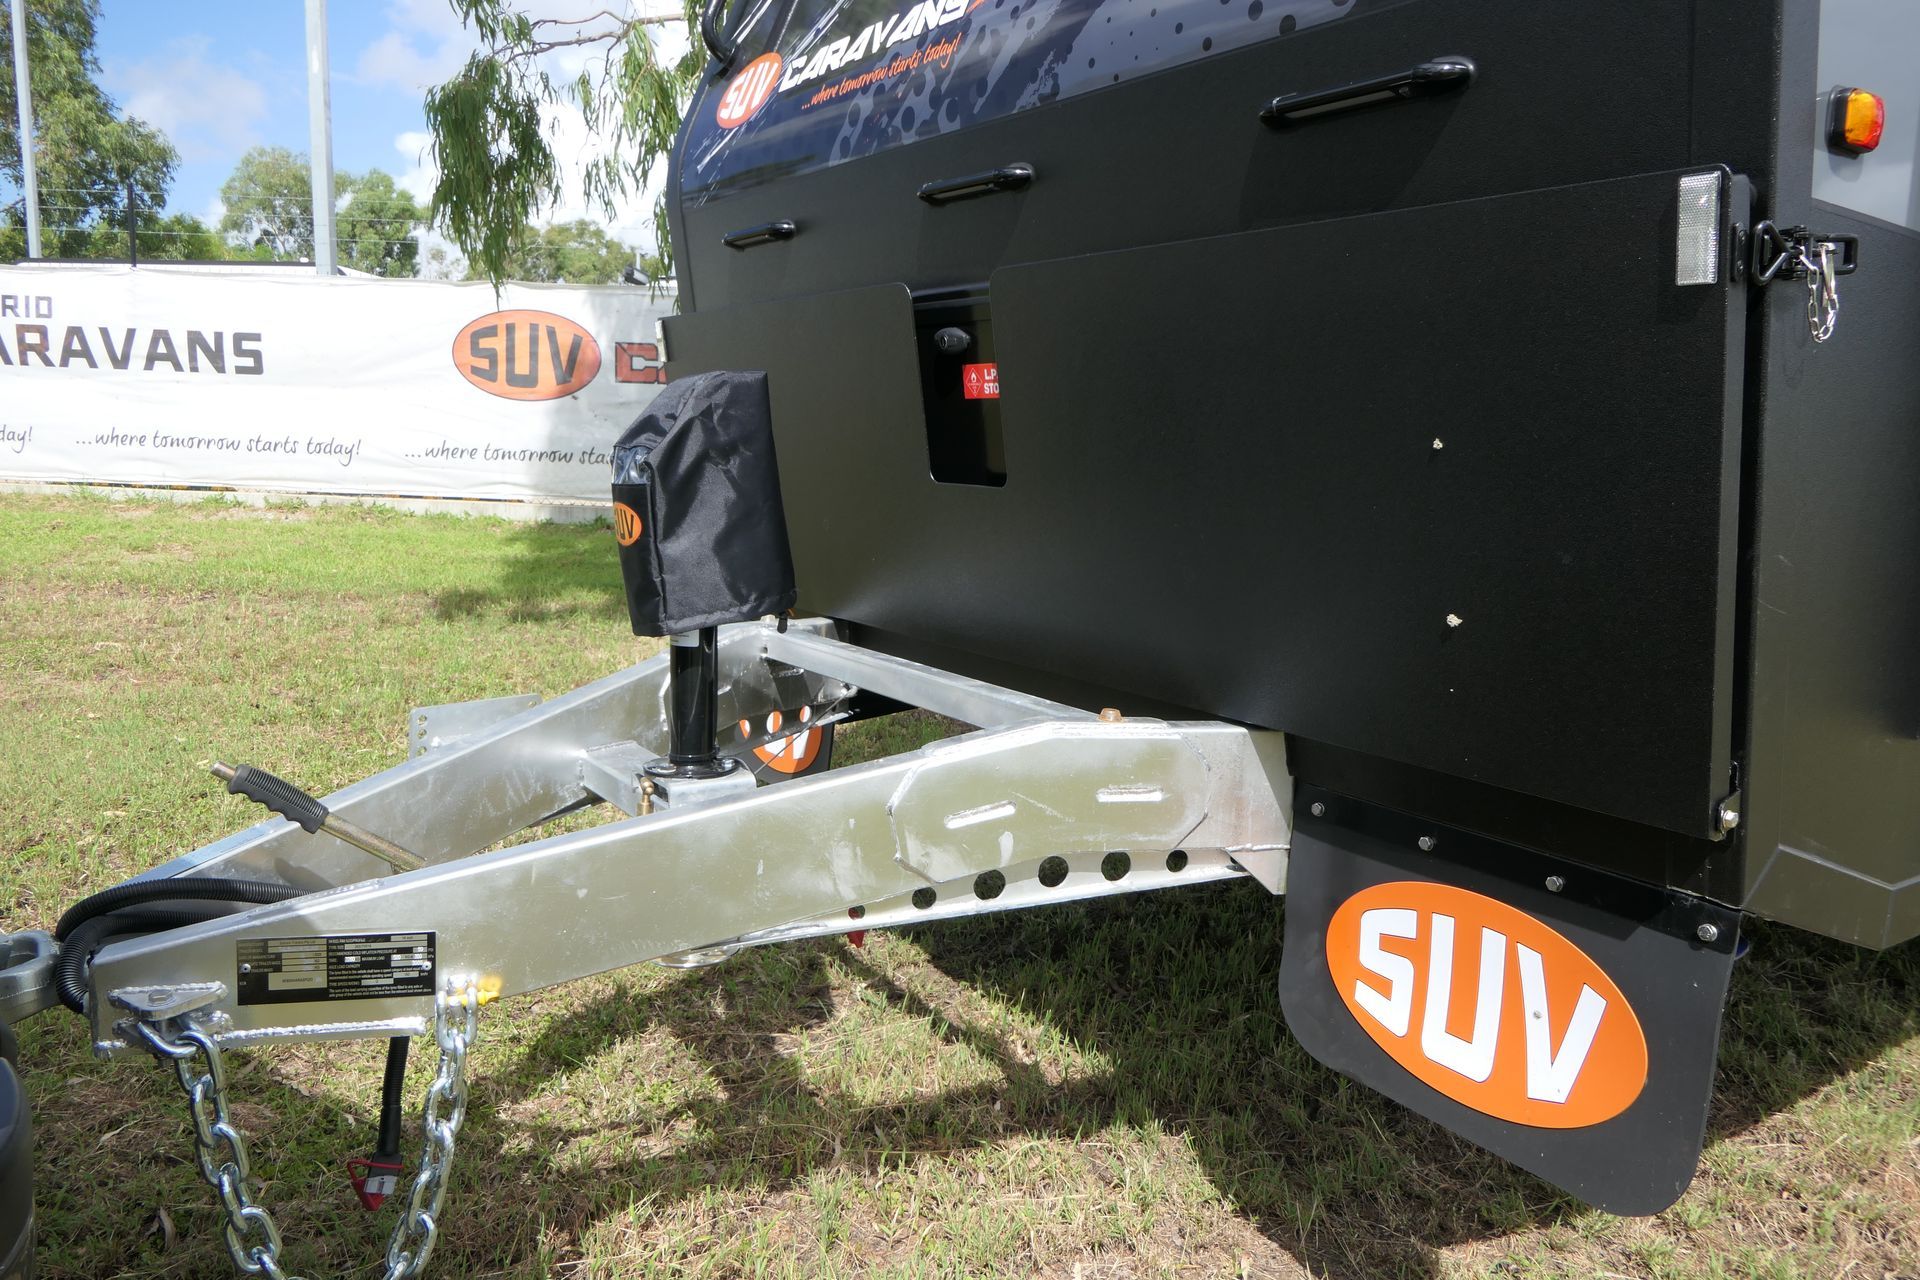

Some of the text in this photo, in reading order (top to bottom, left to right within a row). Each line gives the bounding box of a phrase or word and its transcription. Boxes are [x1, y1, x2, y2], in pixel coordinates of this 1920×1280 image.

[778, 0, 969, 92] CARAVANS
[840, 63, 889, 96] tomorrow
[888, 48, 923, 78] starts
[923, 31, 963, 69] today!
[719, 61, 779, 119] SUV
[470, 322, 584, 388] SUV
[614, 341, 668, 384] C
[152, 430, 242, 450] tomorrow
[246, 434, 299, 454] starts
[306, 436, 362, 467] today!
[483, 443, 573, 464] tomorrow
[1354, 908, 1608, 1104] SUV
